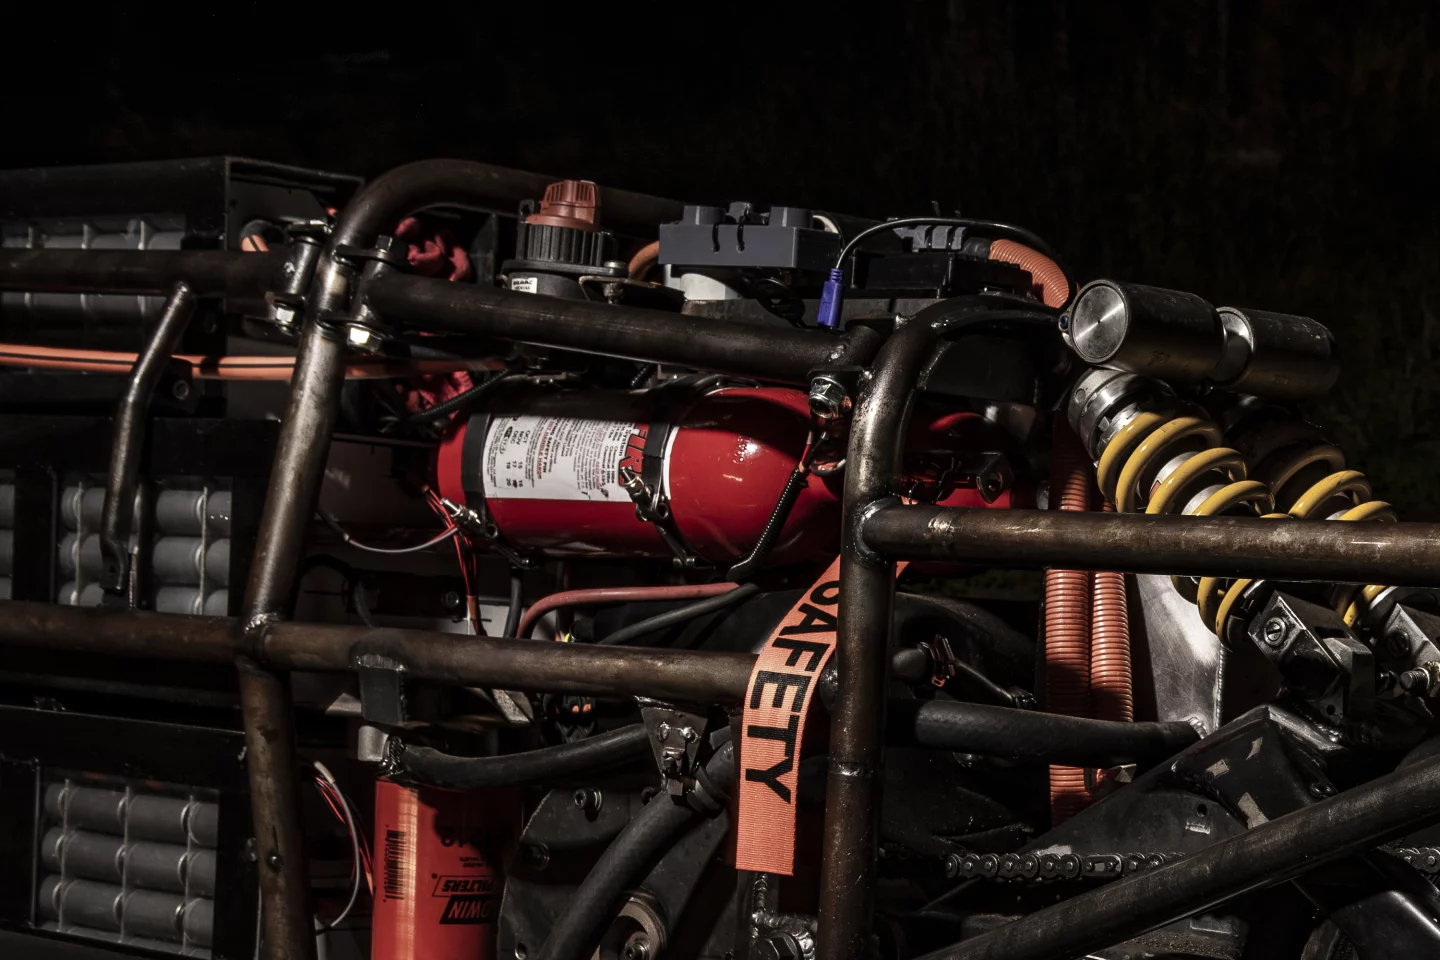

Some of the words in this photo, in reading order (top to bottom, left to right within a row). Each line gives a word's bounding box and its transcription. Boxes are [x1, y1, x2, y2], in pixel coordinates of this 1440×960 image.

[511, 430, 519, 445] DEC
[516, 431, 525, 446] NOV
[544, 437, 553, 460] SAFETY
[442, 879, 493, 893] FILTERS
